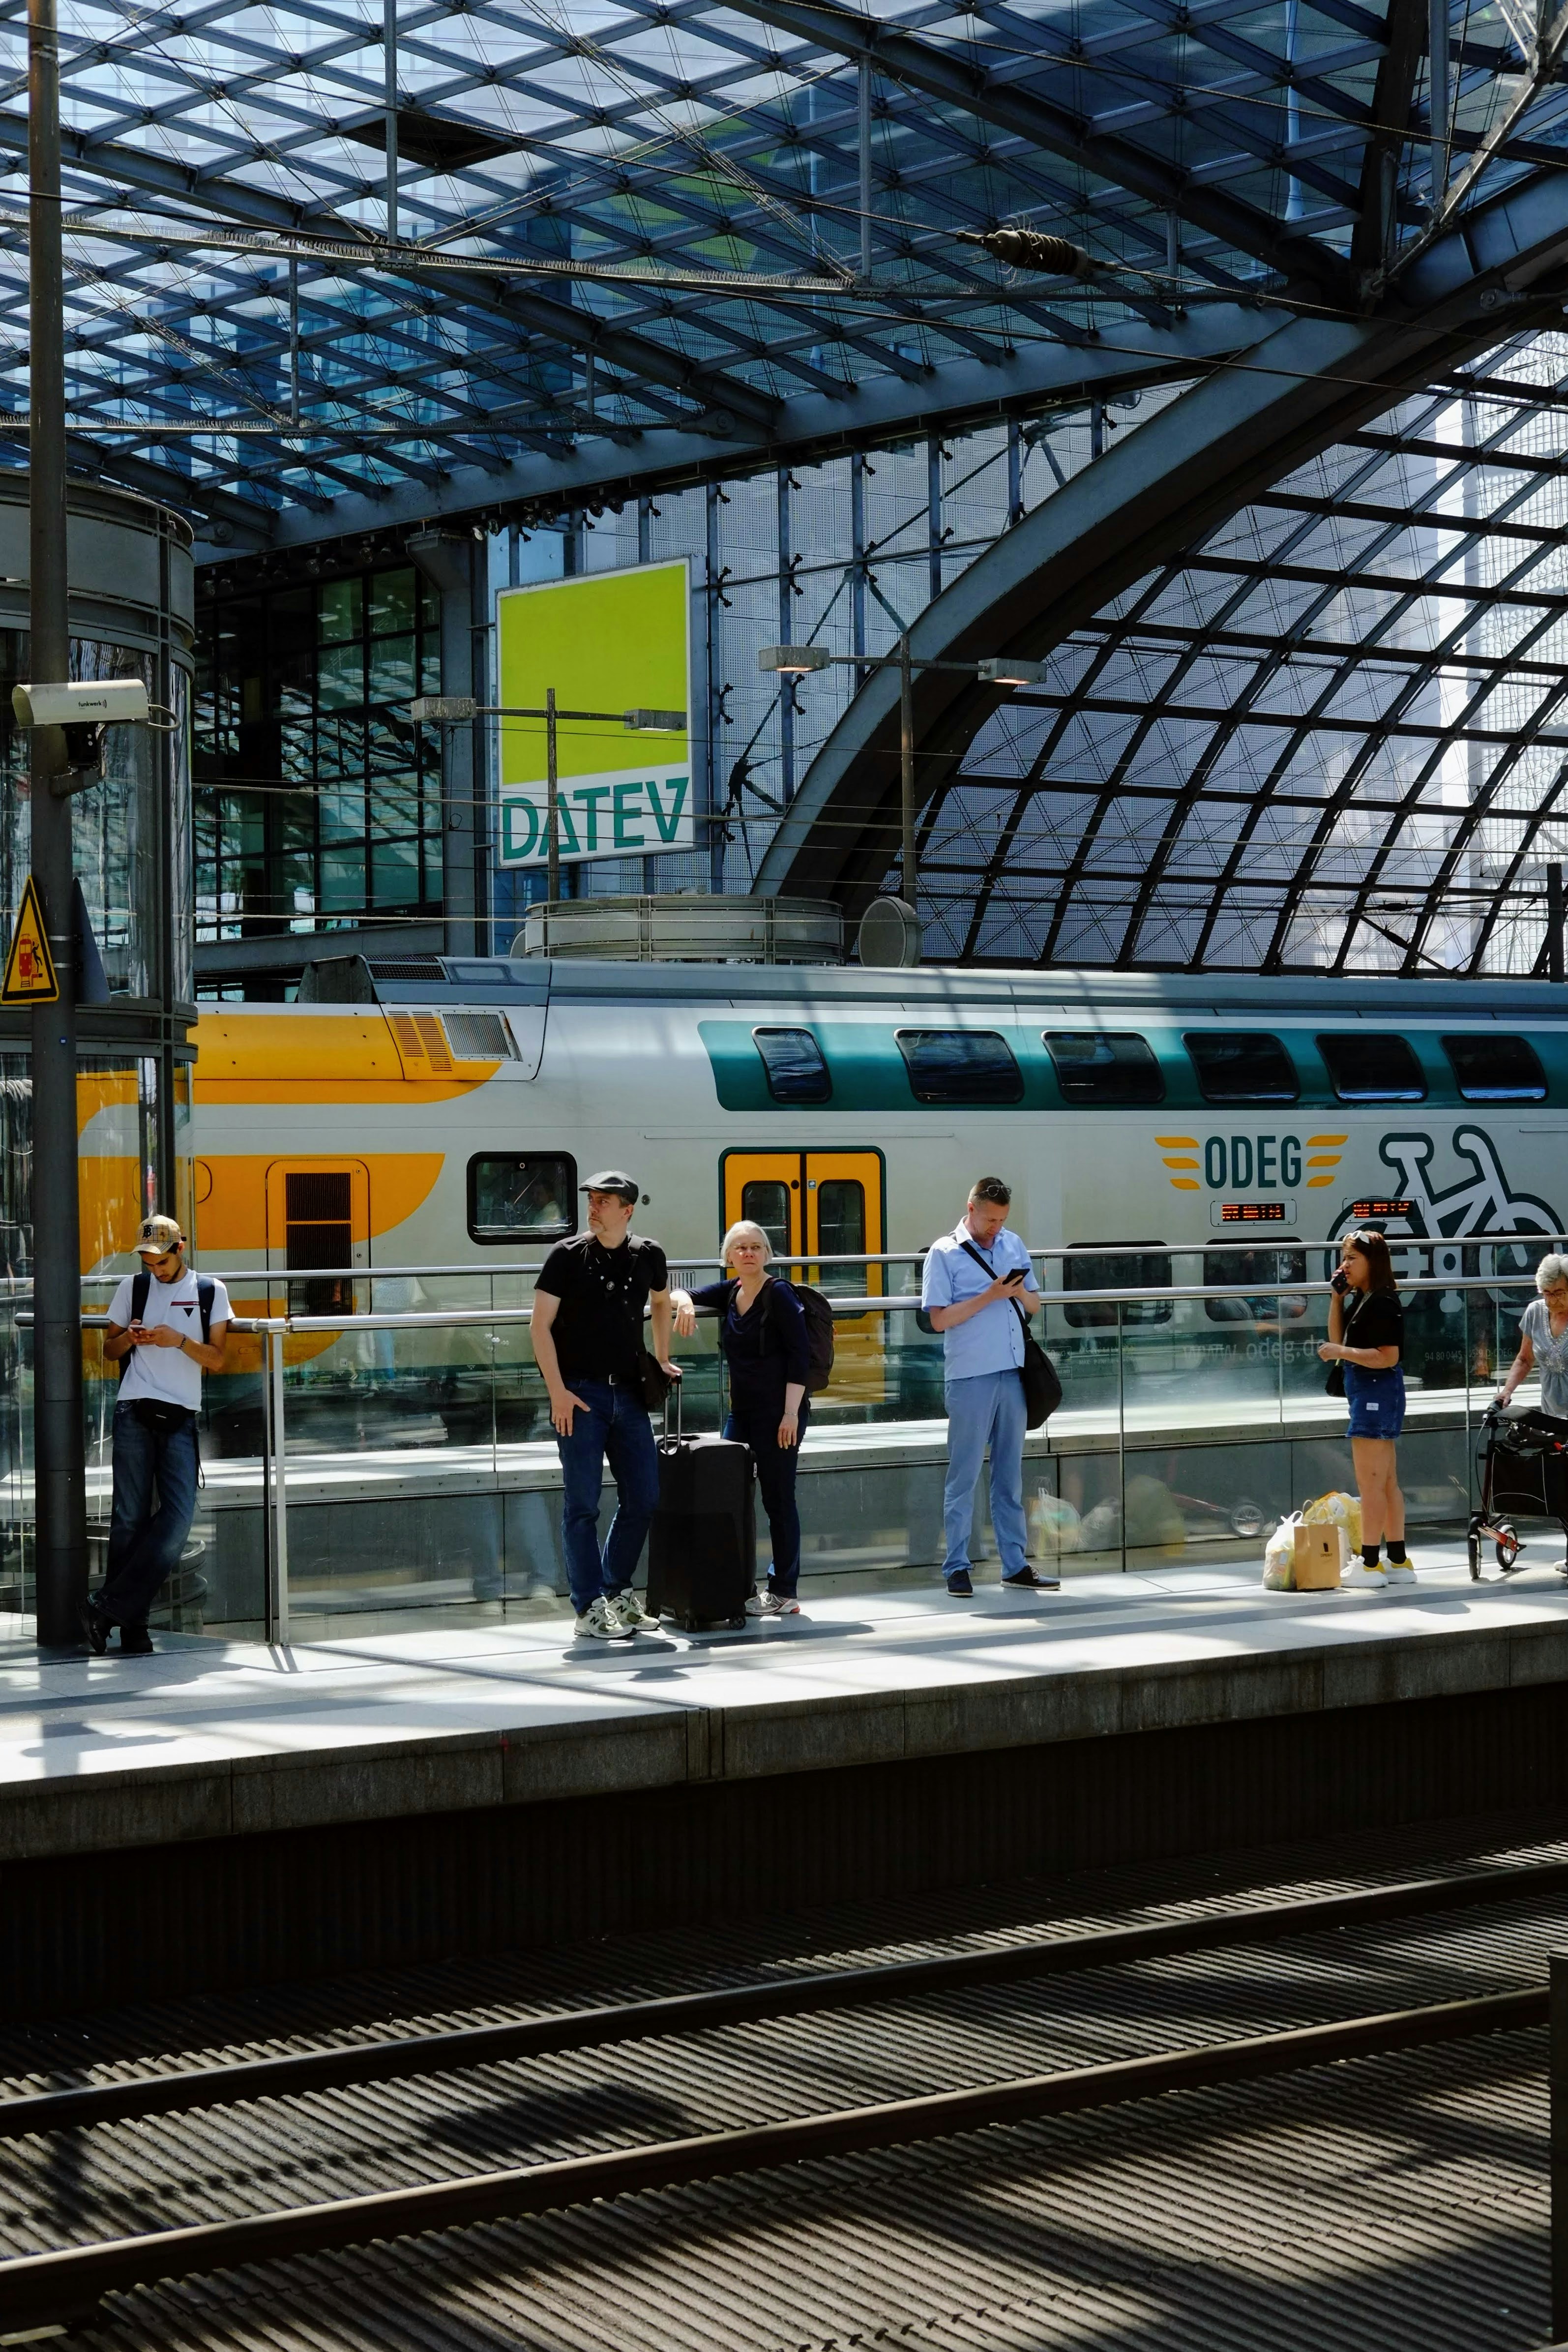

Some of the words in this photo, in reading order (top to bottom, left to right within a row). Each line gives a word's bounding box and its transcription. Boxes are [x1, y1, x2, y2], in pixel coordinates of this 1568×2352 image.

[503, 776, 689, 860] DATEV
[1205, 1135, 1302, 1189] ODEG
[590, 1616, 600, 1625] N
